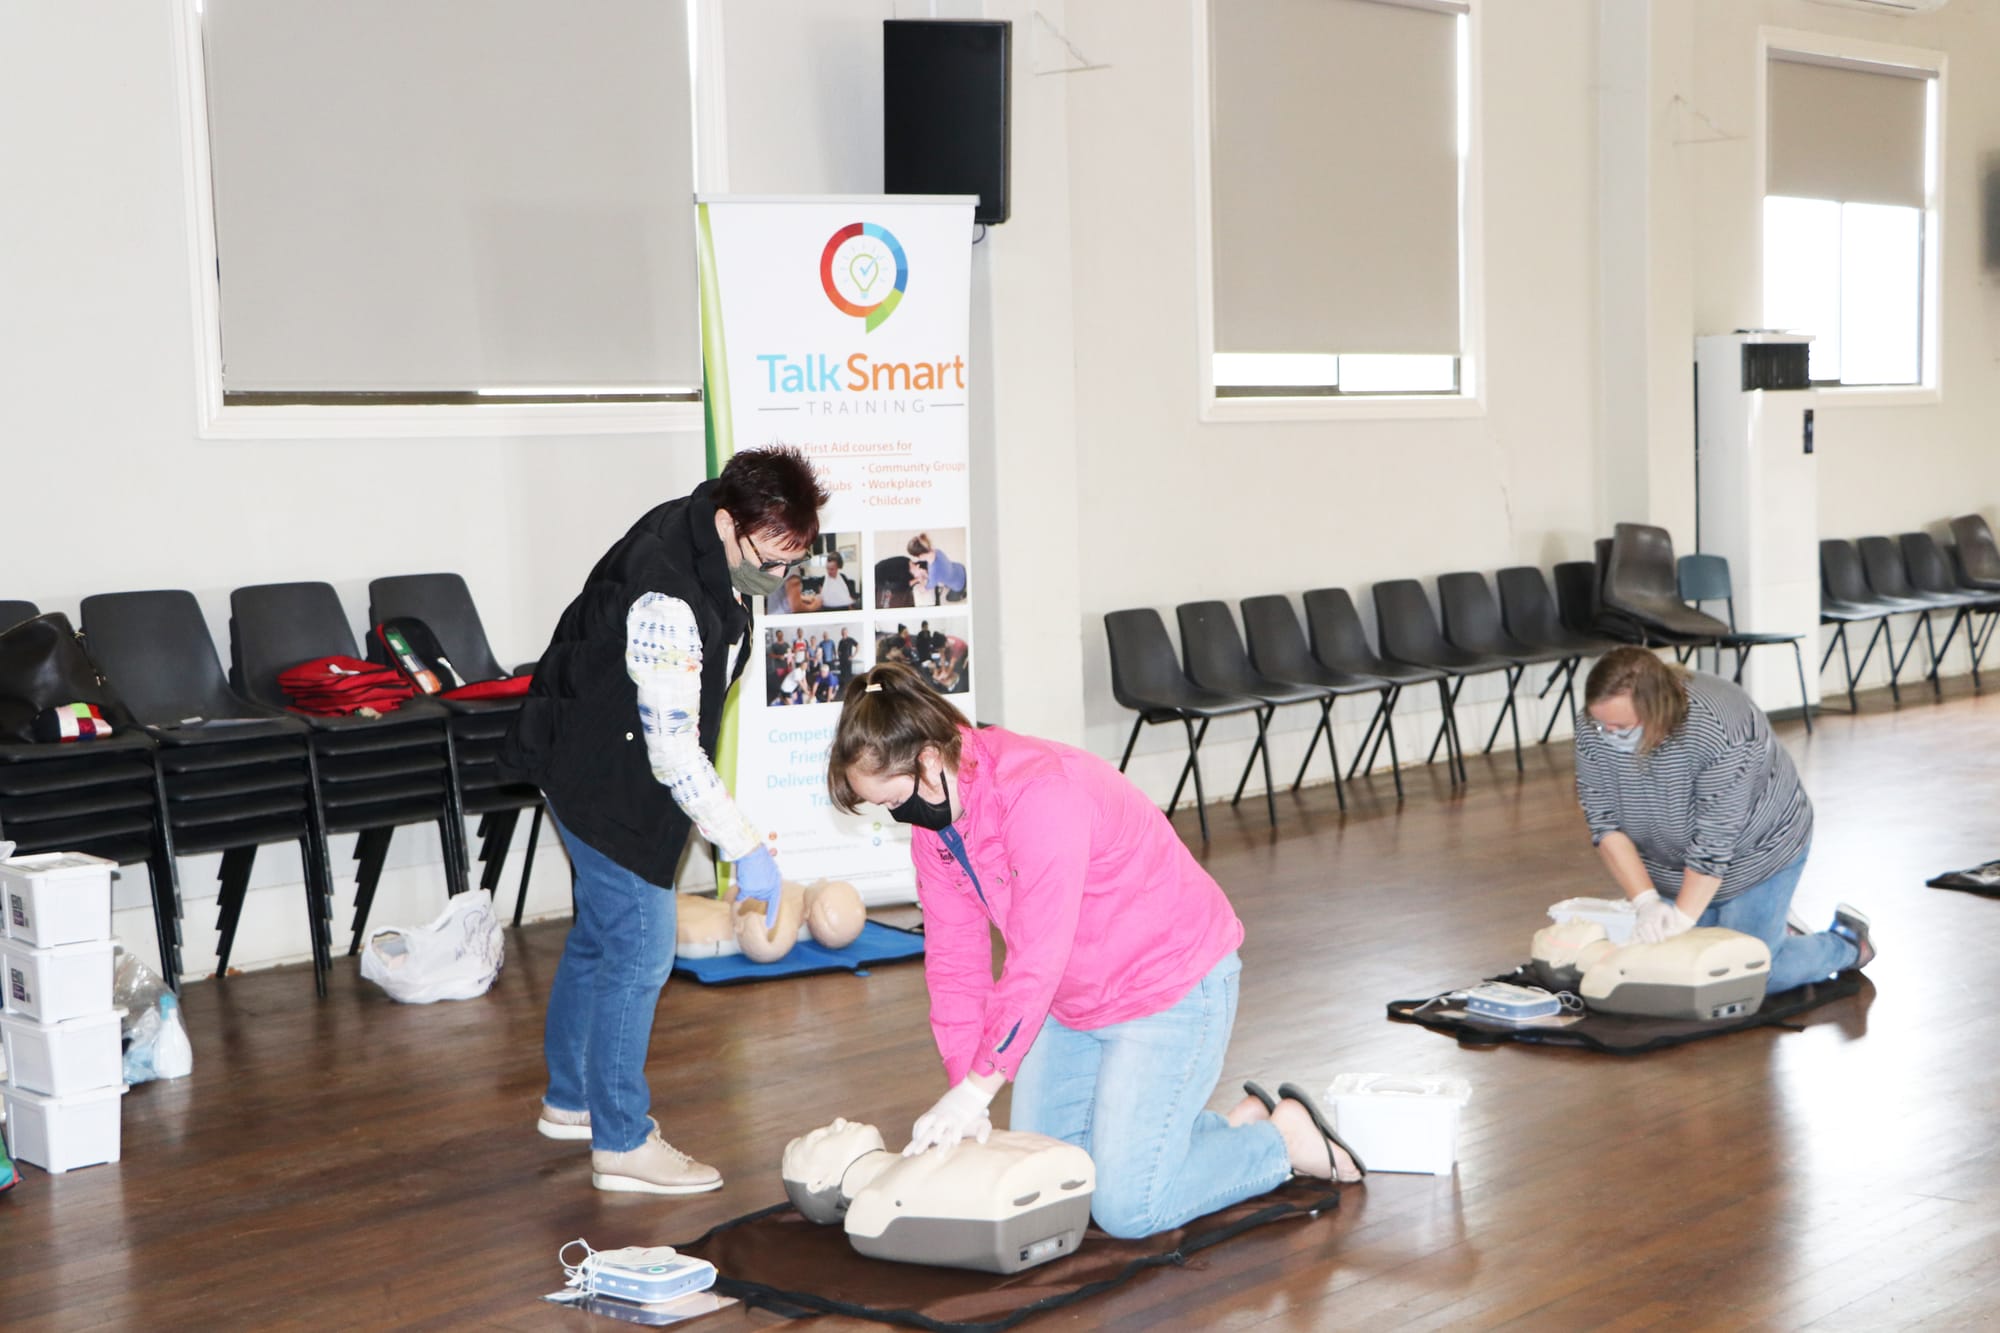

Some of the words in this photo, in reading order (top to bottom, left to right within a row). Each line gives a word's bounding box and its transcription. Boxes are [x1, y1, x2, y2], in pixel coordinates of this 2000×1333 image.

[756, 353, 842, 394] Talk
[847, 353, 965, 392] Smart
[806, 399, 926, 417] TRAINING
[804, 442, 828, 454] First
[831, 442, 849, 453] Aid
[852, 443, 894, 453] courses
[896, 440, 912, 451] for
[868, 462, 930, 475] Community
[868, 478, 933, 491] Workplaces
[868, 493, 921, 506] Childcare
[768, 727, 834, 744] Competi
[790, 750, 829, 765] Frien
